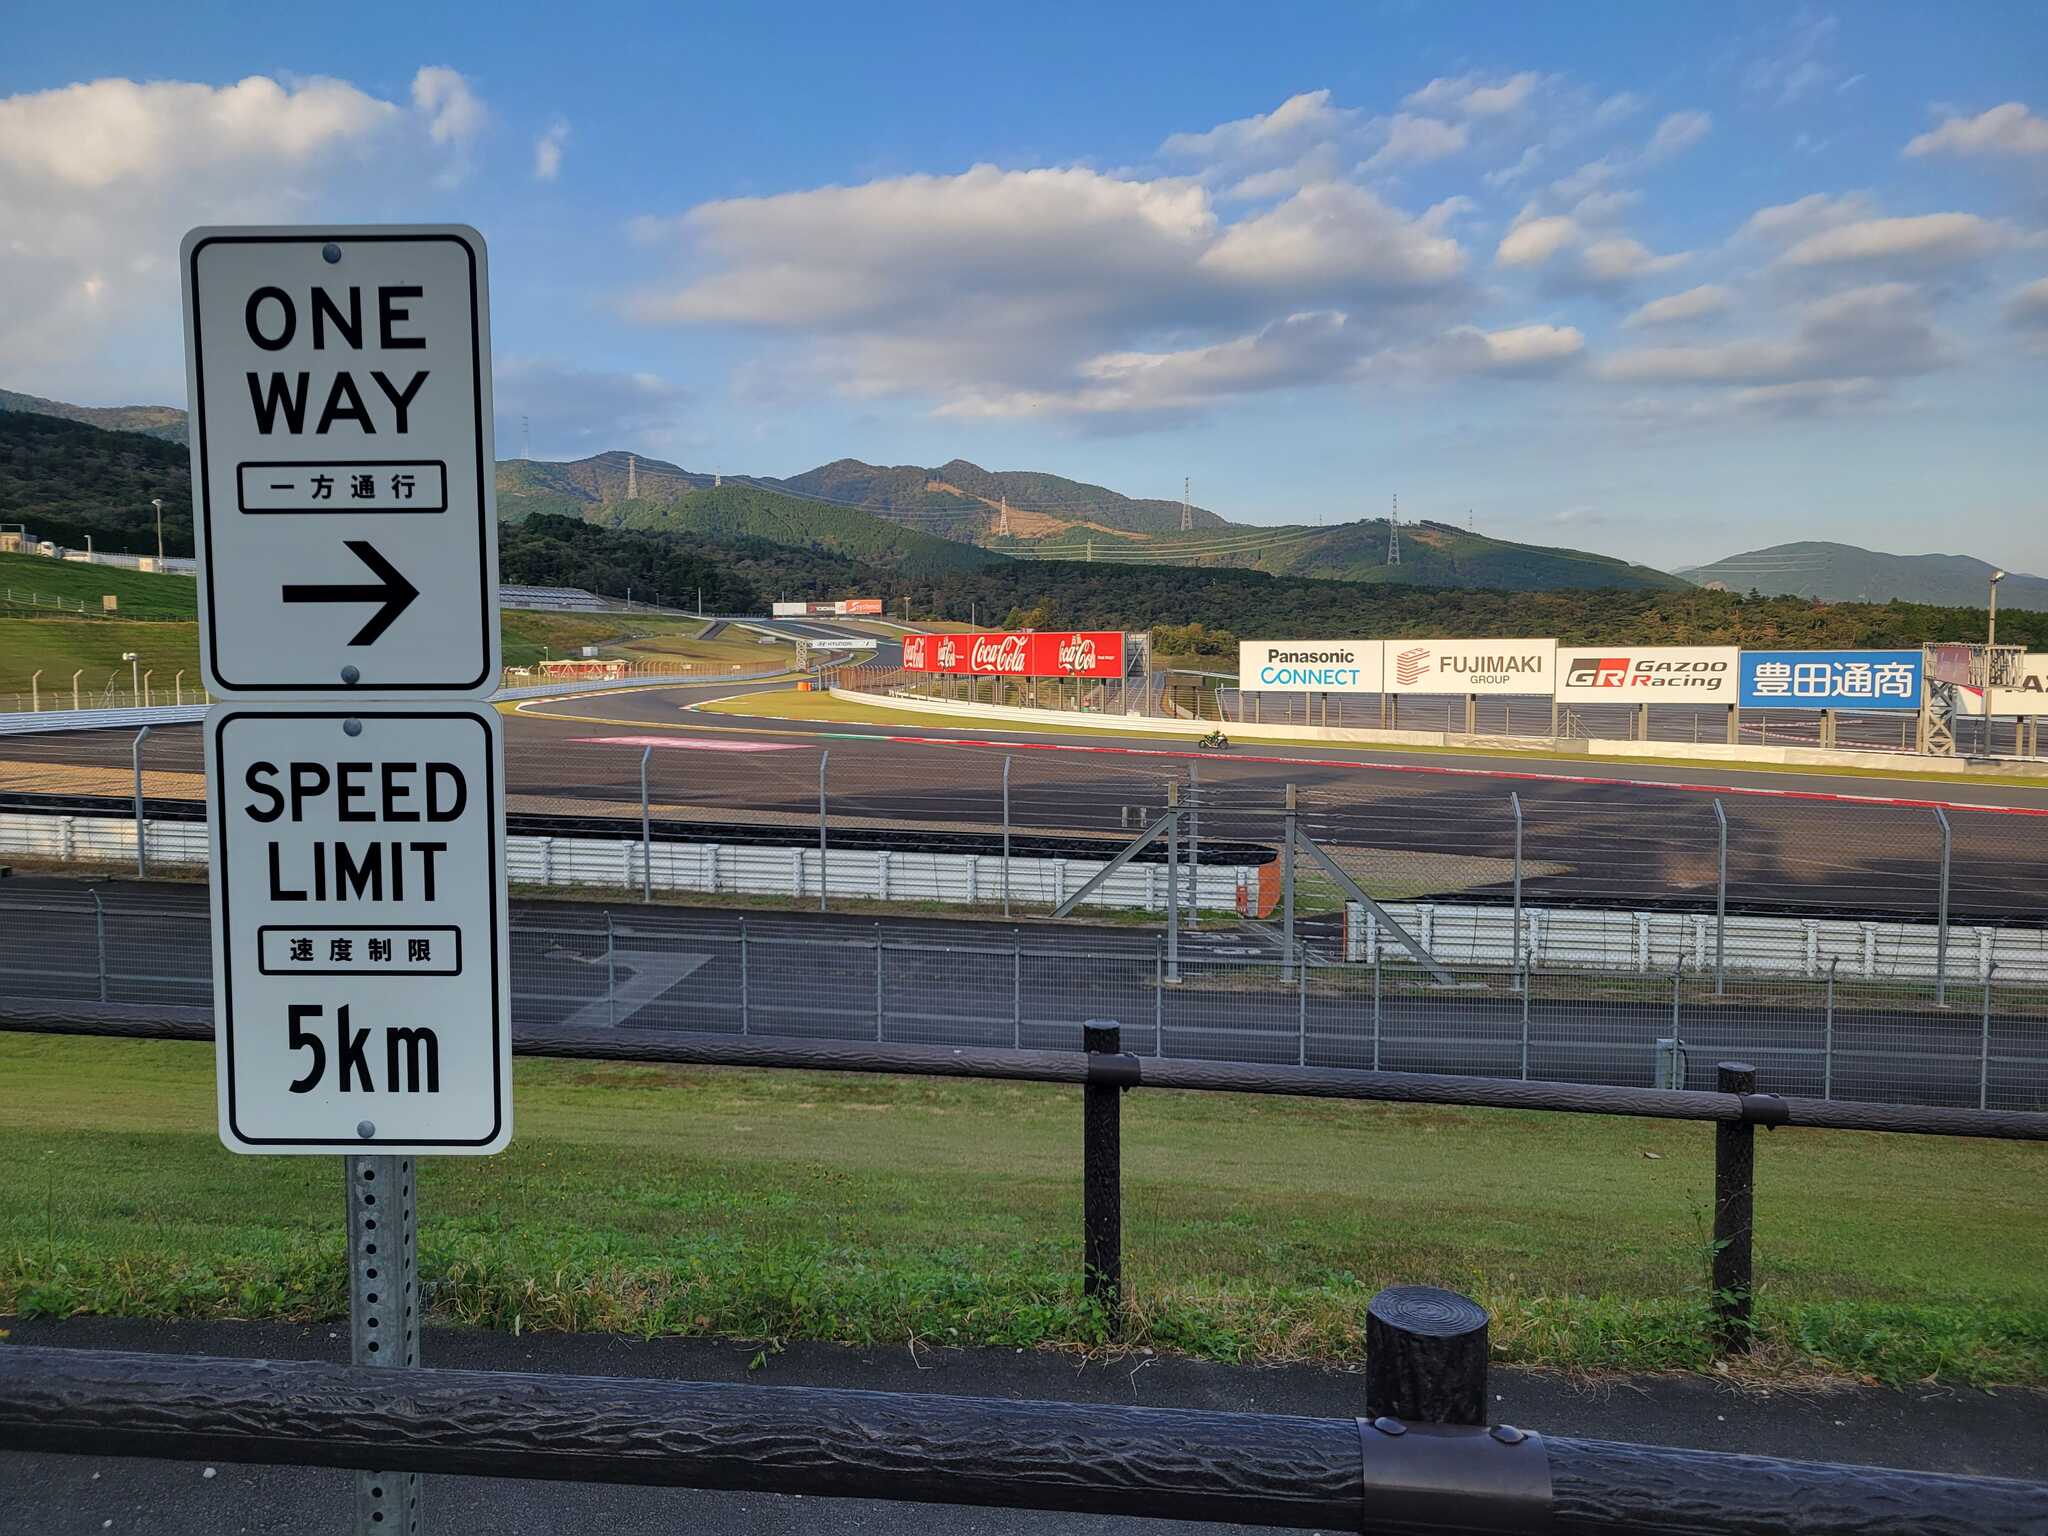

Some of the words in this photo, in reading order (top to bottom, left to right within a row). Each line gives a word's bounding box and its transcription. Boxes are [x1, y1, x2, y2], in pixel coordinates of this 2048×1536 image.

[245, 285, 427, 351] ONE
[246, 370, 430, 435] WAY
[270, 473, 416, 500] 一方通行
[971, 636, 1028, 672] Coca-Cola
[1268, 648, 1355, 664] Panasonic
[1440, 655, 1542, 673] FUJIMAKI
[1635, 660, 1728, 672] GAZOO
[1260, 666, 1361, 686] CONNECT
[1470, 675, 1510, 684] GROUP
[1567, 667, 1626, 687] GR
[1630, 674, 1723, 690] Racing
[1752, 661, 1915, 698] 豊田通商
[244, 761, 468, 823] SPEED
[268, 841, 448, 902] LIMIT
[289, 937, 432, 963] 速度制限
[287, 1003, 440, 1094] 5km
